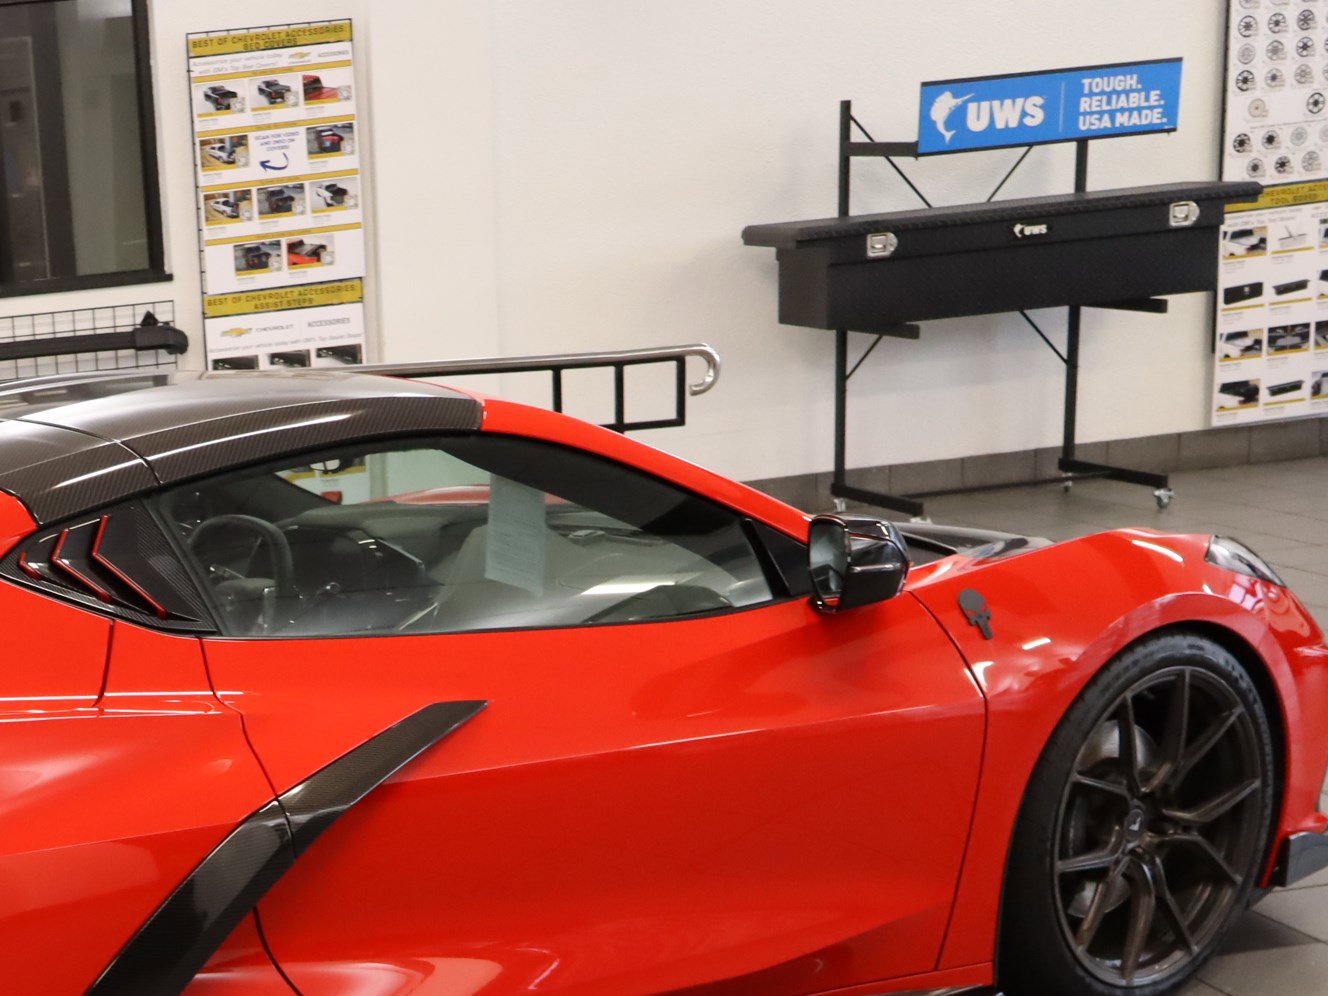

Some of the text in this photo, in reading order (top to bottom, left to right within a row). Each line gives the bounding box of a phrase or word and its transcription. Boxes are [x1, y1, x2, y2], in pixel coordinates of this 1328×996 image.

[192, 24, 344, 49] BEST OF CHEVROLET ACCESSORIES
[1081, 74, 1142, 94] TOUGH.
[1079, 90, 1165, 113] RELIABLE.
[966, 95, 1046, 132] UWS
[1078, 108, 1168, 131] USA MADE.
[1023, 224, 1048, 236] UWS
[207, 284, 355, 307] BEST OF CHEVROLET ACCESSORIES
[253, 297, 314, 310] ASSIST STEPS
